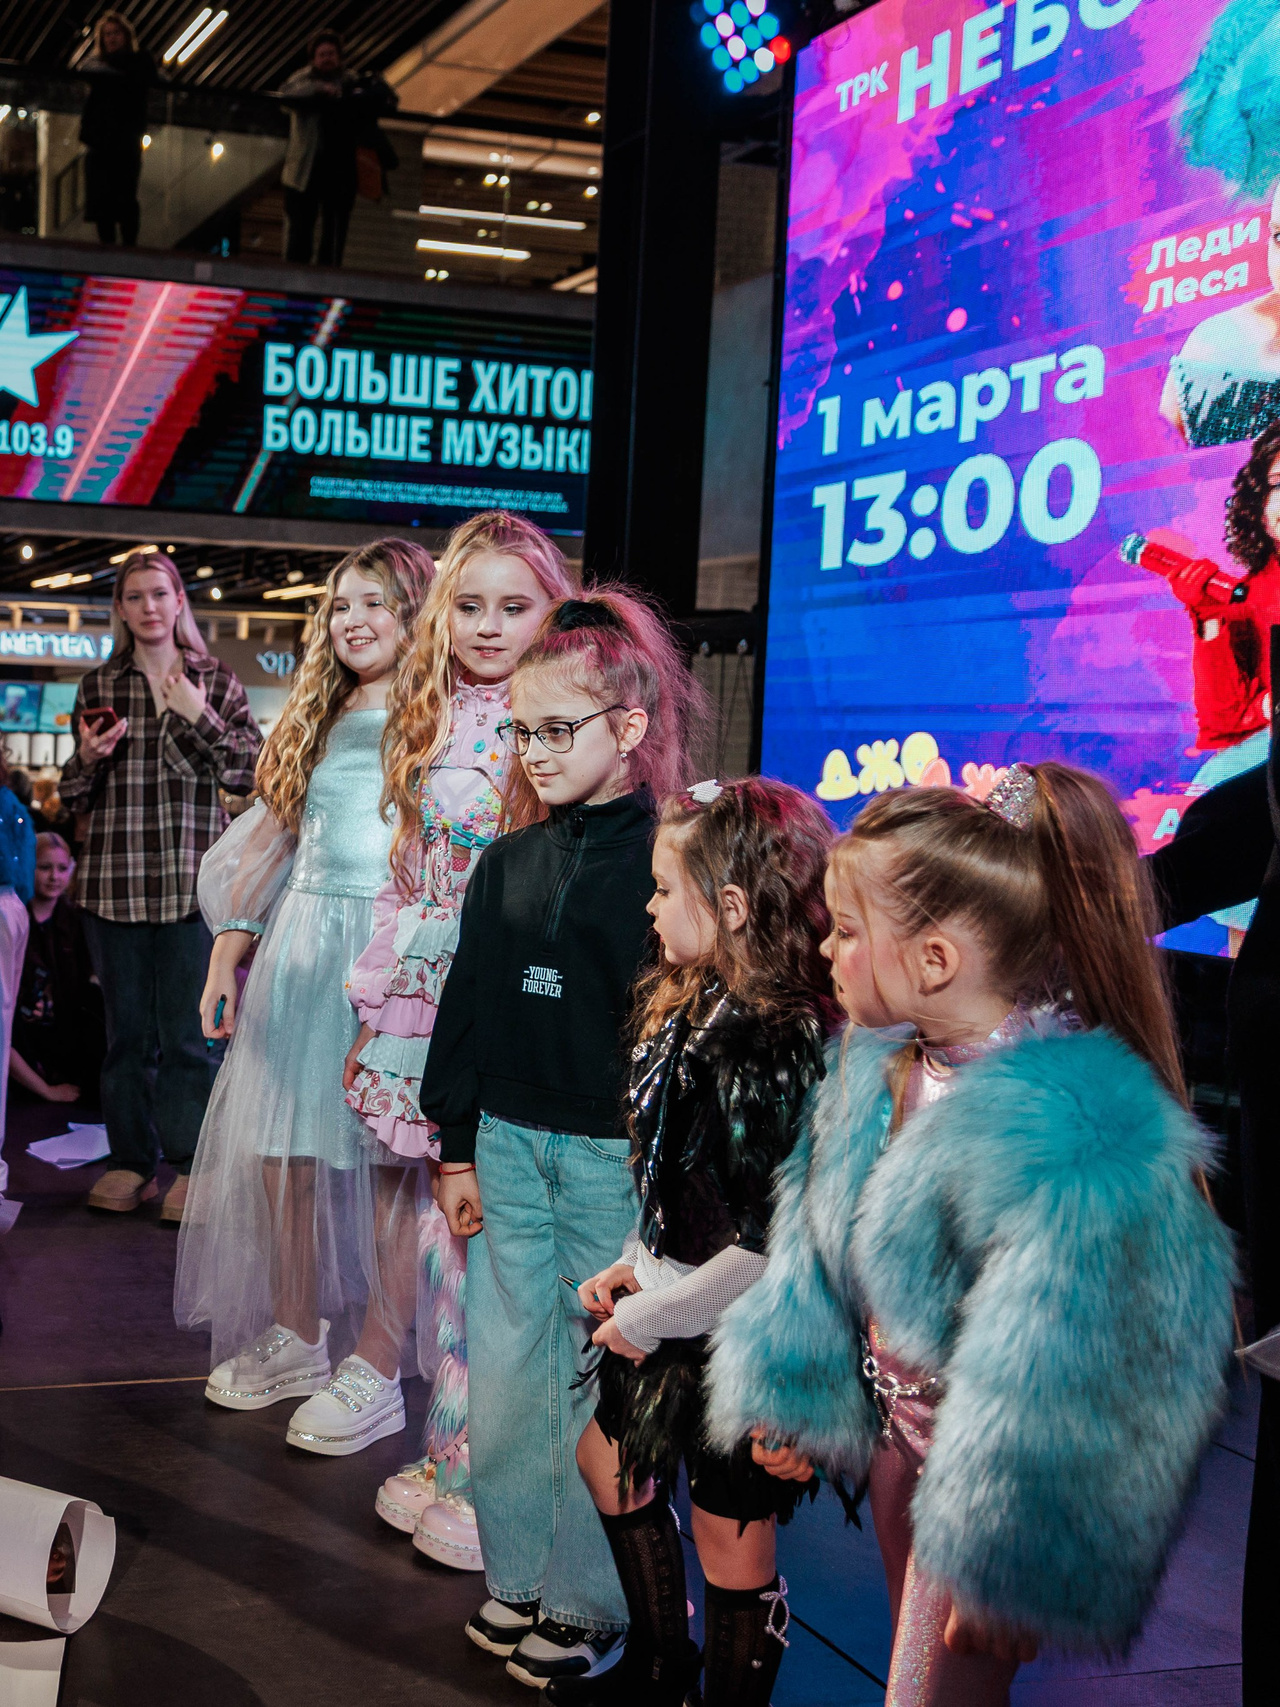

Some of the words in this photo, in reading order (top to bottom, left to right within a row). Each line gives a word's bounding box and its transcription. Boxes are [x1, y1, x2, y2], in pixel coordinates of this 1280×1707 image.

[836, 61, 889, 113] ТРК
[1143, 213, 1263, 274] Леди
[1141, 260, 1250, 314] Леся
[262, 341, 462, 411] БОЛЬШЕ
[816, 394, 842, 456] 1
[861, 343, 1106, 447] марта
[262, 403, 434, 463] БОЛЬШЕ
[811, 437, 1102, 572] 13:00
[815, 731, 940, 801] ДЖО
[522, 978, 562, 998] FOREVER
